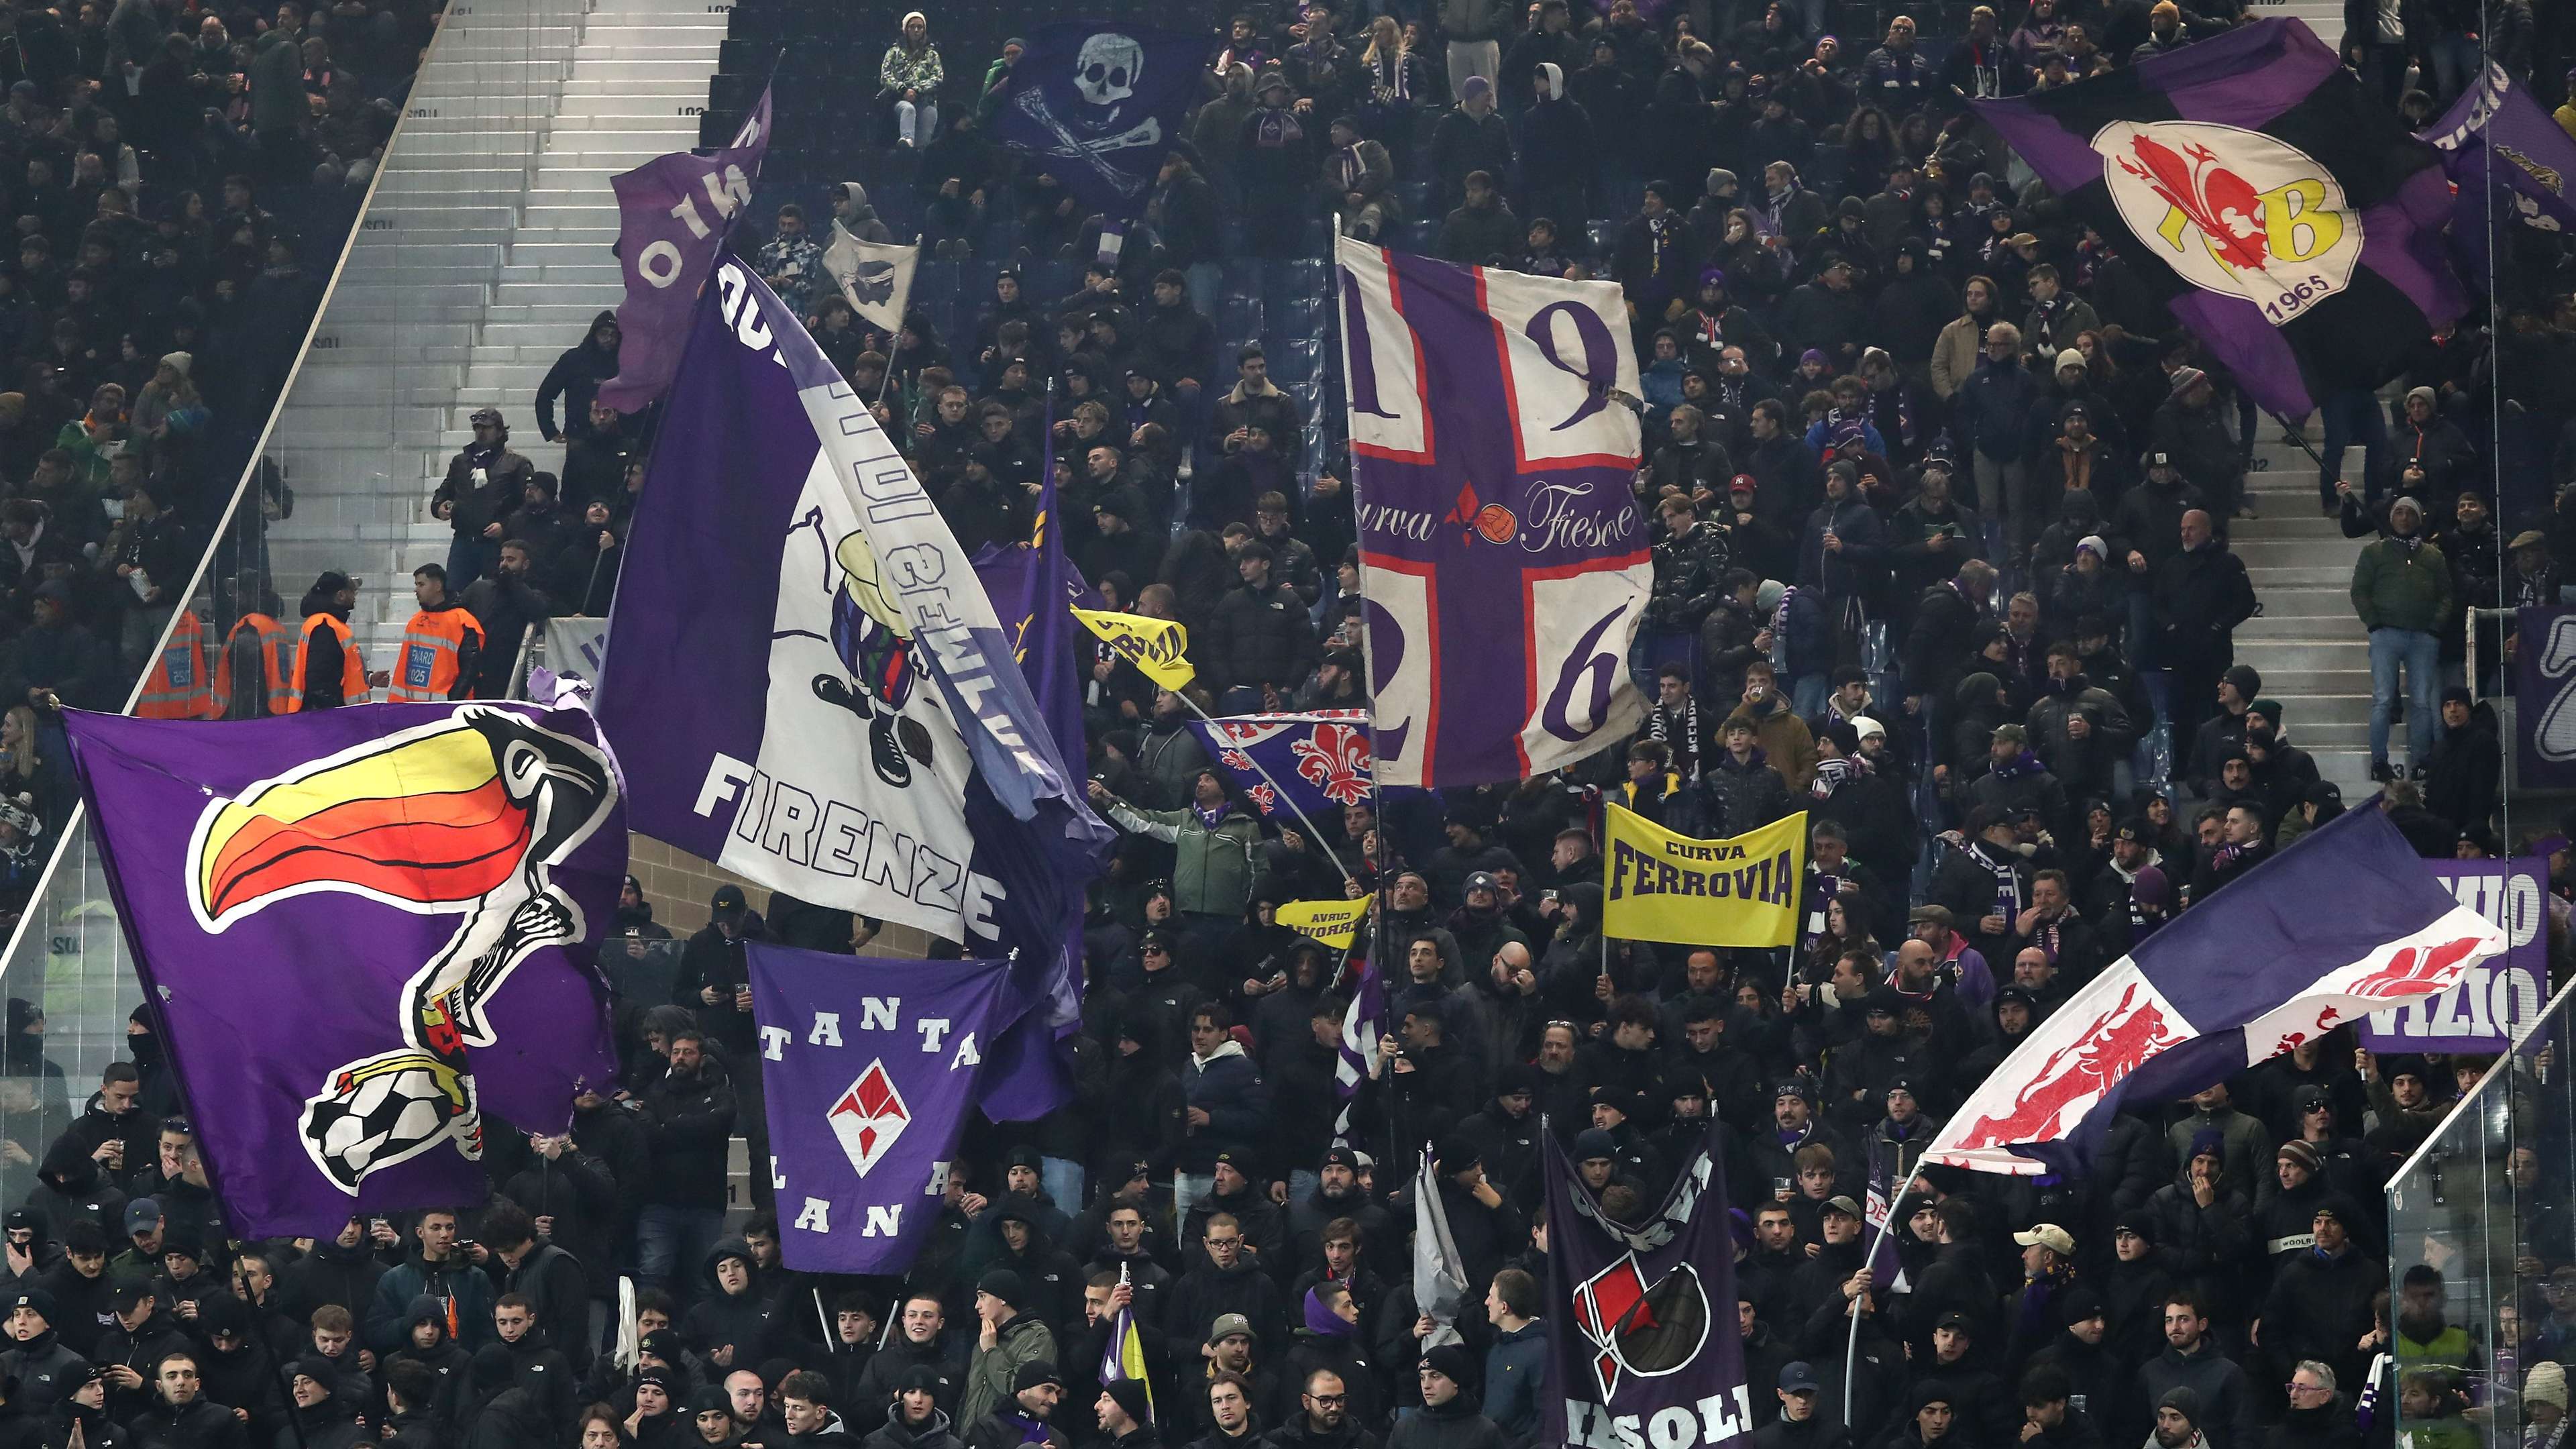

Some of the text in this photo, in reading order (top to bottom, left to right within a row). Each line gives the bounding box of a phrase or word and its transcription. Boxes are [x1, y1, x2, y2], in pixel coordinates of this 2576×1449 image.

[2265, 275, 2330, 320] 1965
[693, 751, 1006, 941] FIRENZE
[1609, 838, 1792, 909] FERROVIA
[1666, 841, 1746, 861] CURVA
[759, 997, 981, 1071] TANTA
